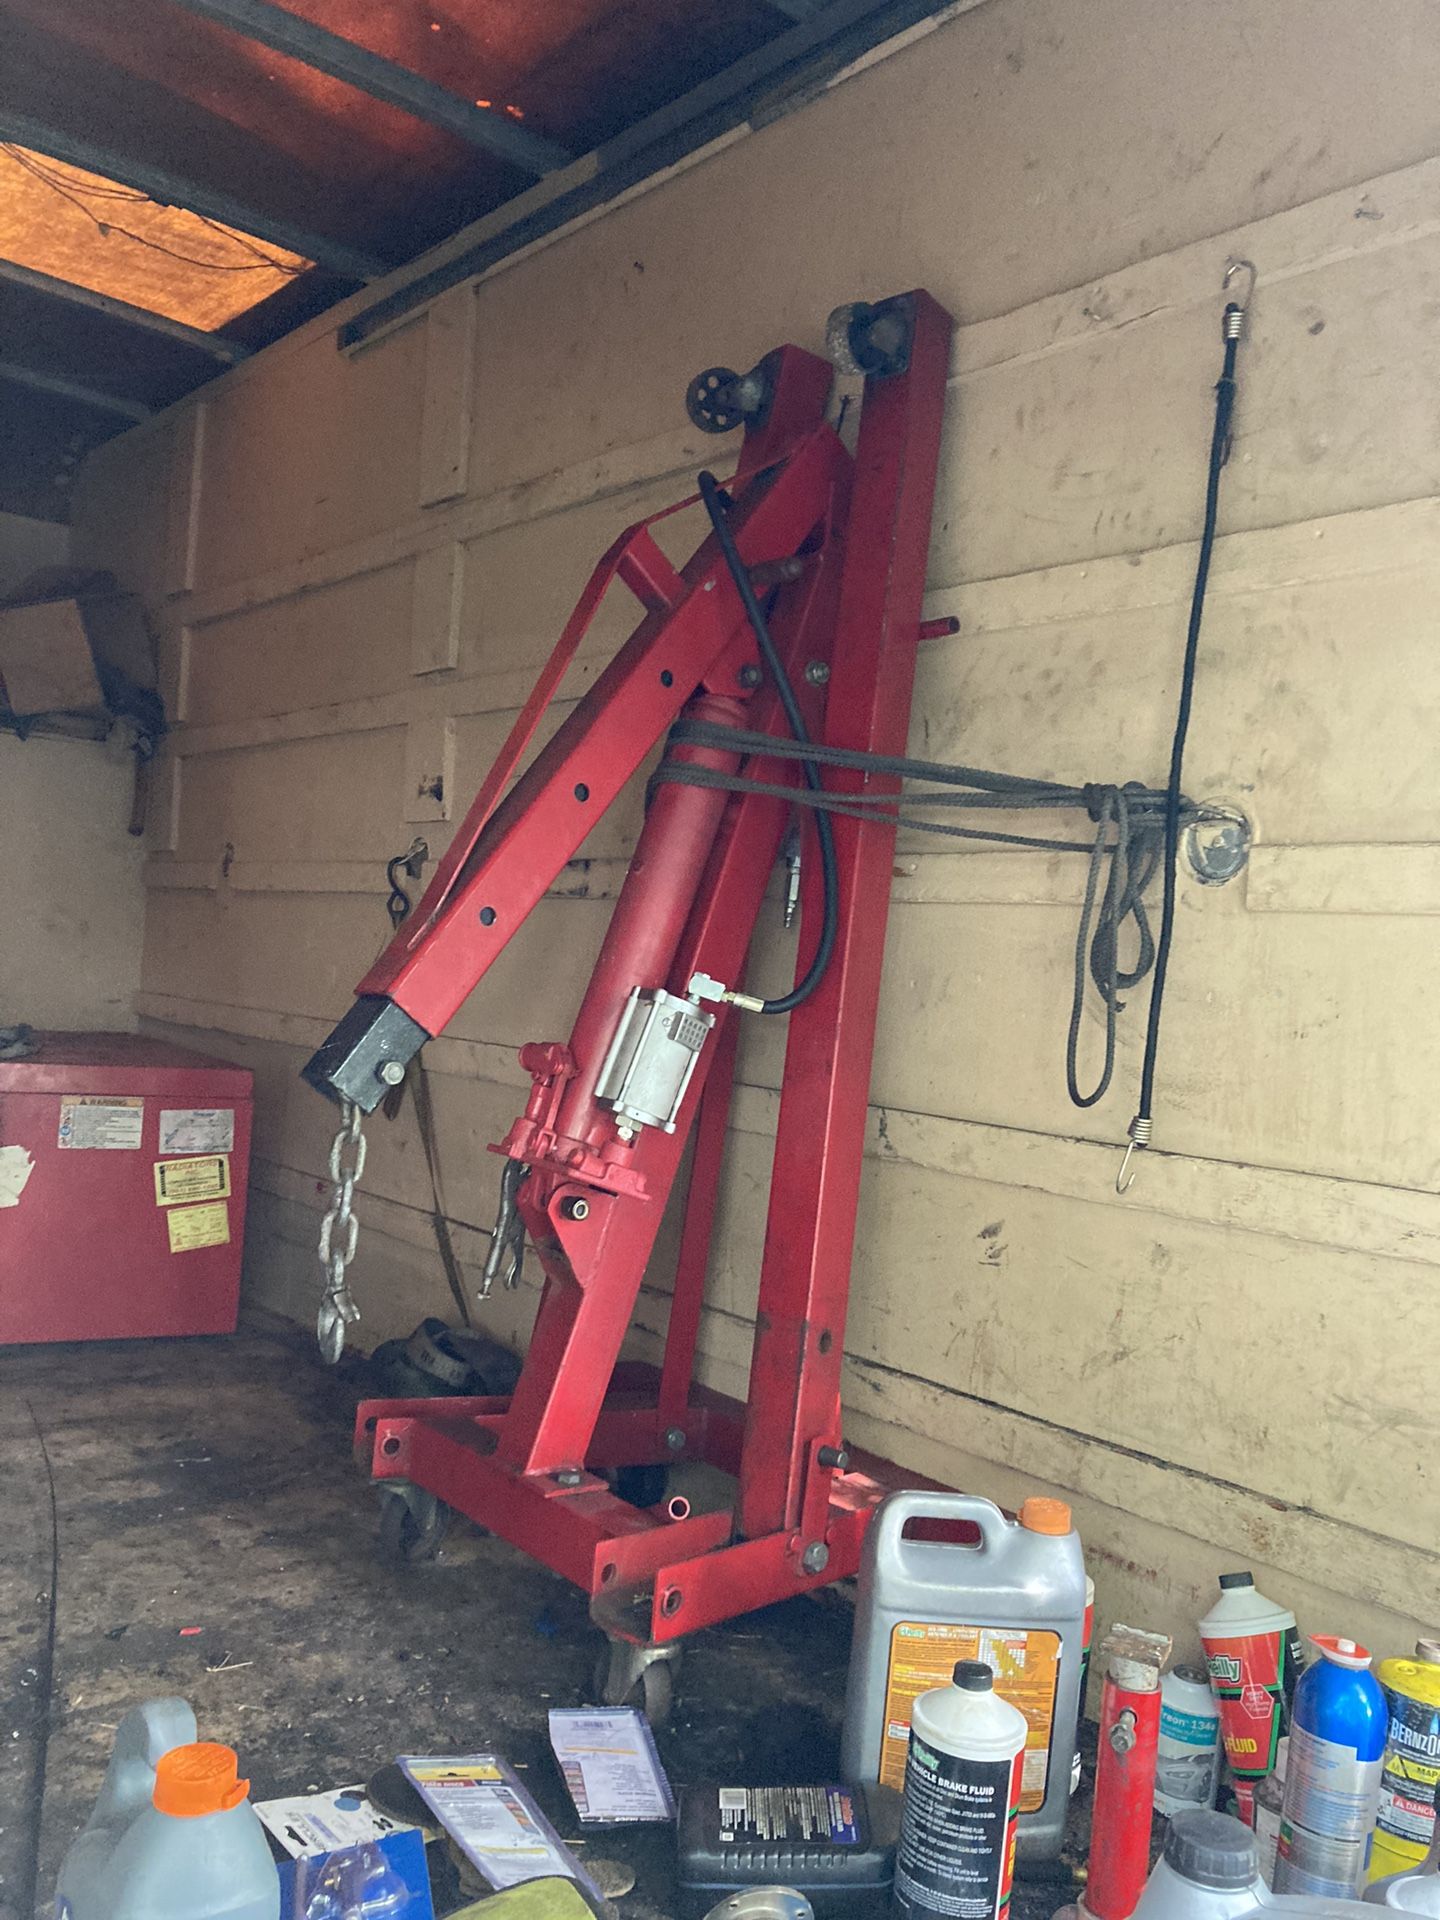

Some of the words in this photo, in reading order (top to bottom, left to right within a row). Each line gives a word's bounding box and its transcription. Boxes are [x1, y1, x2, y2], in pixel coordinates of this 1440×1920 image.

[1162, 1712, 1185, 1727] reon
[938, 1777, 967, 1794] BRAKE
[969, 1785, 995, 1796] FLUID
[1405, 1801, 1436, 1816] DANGE
